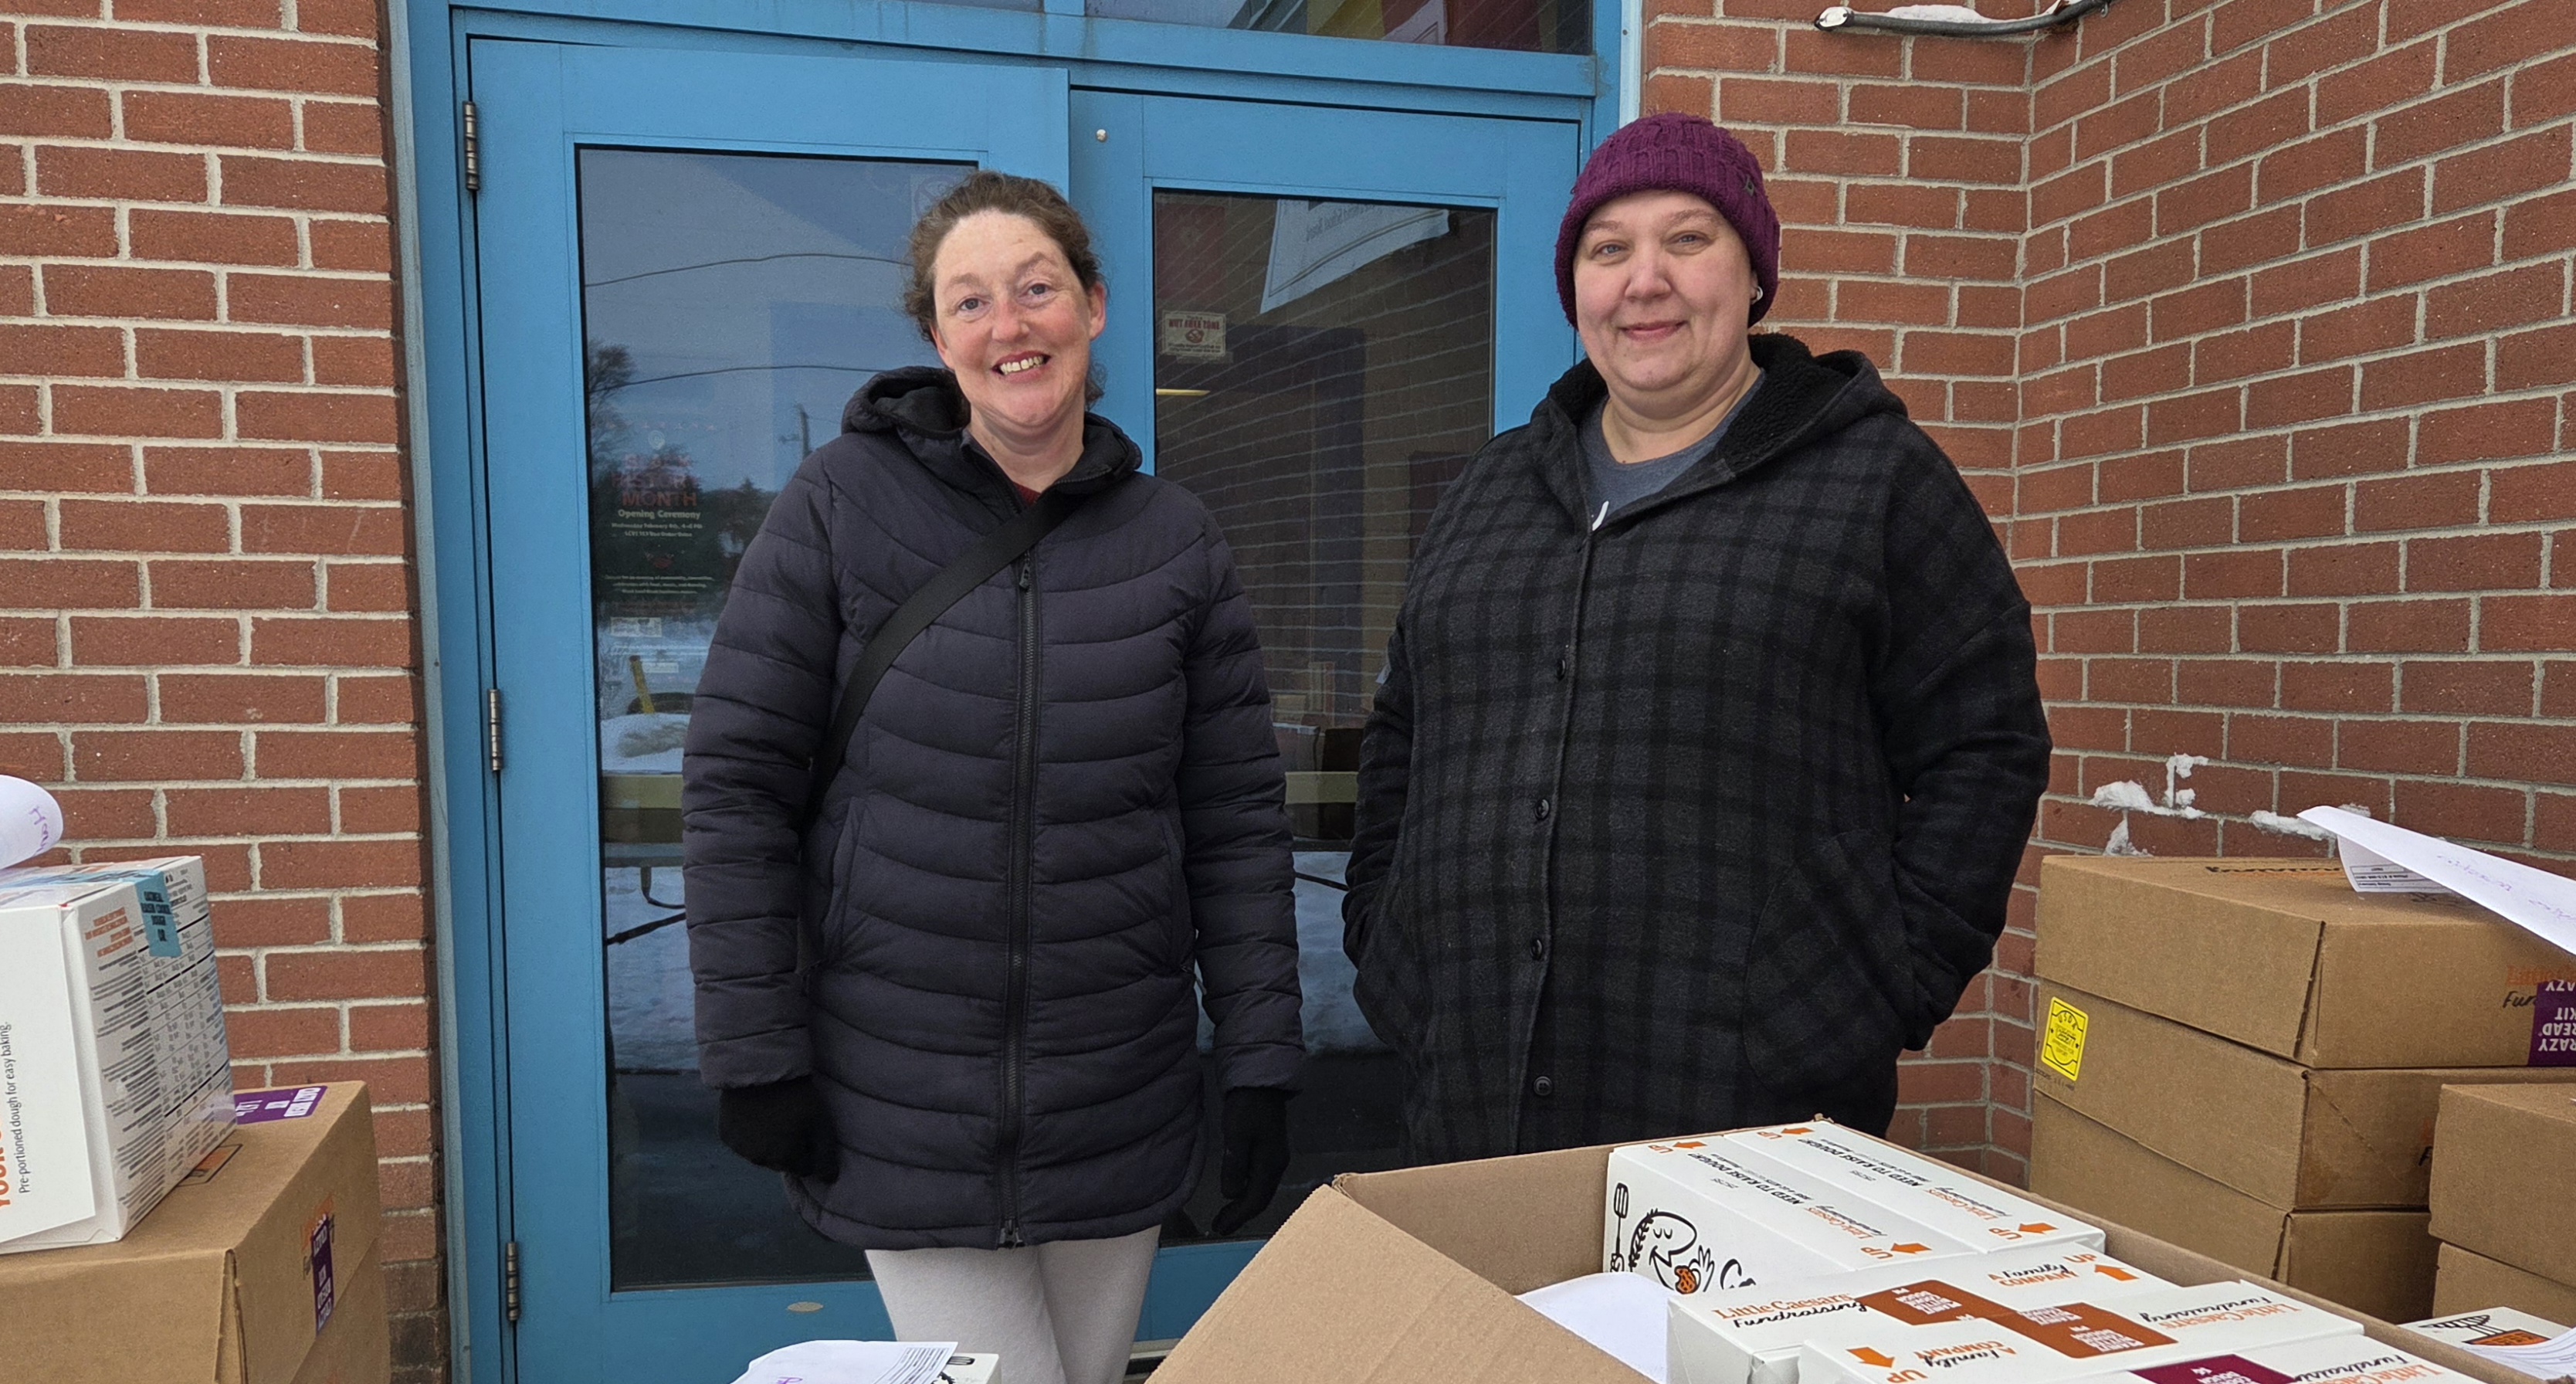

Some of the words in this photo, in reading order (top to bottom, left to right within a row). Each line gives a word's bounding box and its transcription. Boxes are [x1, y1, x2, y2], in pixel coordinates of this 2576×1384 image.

[622, 491, 697, 506] MONTH
[618, 509, 655, 520] Opening
[657, 510, 701, 521] Ceremony
[0, 1022, 12, 1057] baking.
[2, 1058, 16, 1080] easy
[5, 1082, 17, 1095] for
[5, 1096, 22, 1128] dough
[1757, 1131, 1783, 1140] UP
[1648, 1145, 1674, 1154] UP
[10, 1128, 31, 1194] Pre-portioned
[1840, 1153, 1872, 1169] RAISE
[1728, 1169, 1761, 1186] RAISE
[1872, 1166, 1893, 1175] TO
[1890, 1172, 1924, 1187] NEED
[1756, 1183, 1775, 1193] TO
[1771, 1190, 1805, 1205] NEED
[1988, 1227, 2023, 1240] UP
[1860, 1246, 1893, 1260] UP
[2062, 1253, 2097, 1264] UP
[1998, 1270, 2079, 1287] COMPANY
[2002, 1264, 2071, 1278] Family
[1712, 1304, 1774, 1320] Little
[1776, 1293, 1855, 1311] Caesars
[2138, 1296, 2273, 1322] Fundraising
[2239, 1303, 2302, 1317] Little
[1734, 1301, 1868, 1328] Fundraising
[2158, 1312, 2245, 1329] Caesars
[1914, 1341, 2005, 1359] COMPANY
[1924, 1350, 2000, 1368] Family
[2294, 1354, 2409, 1382] Fundraisin
[2376, 1364, 2444, 1381] Little
[1886, 1369, 1929, 1383] UP
[2308, 1372, 2383, 1384] Caesa
